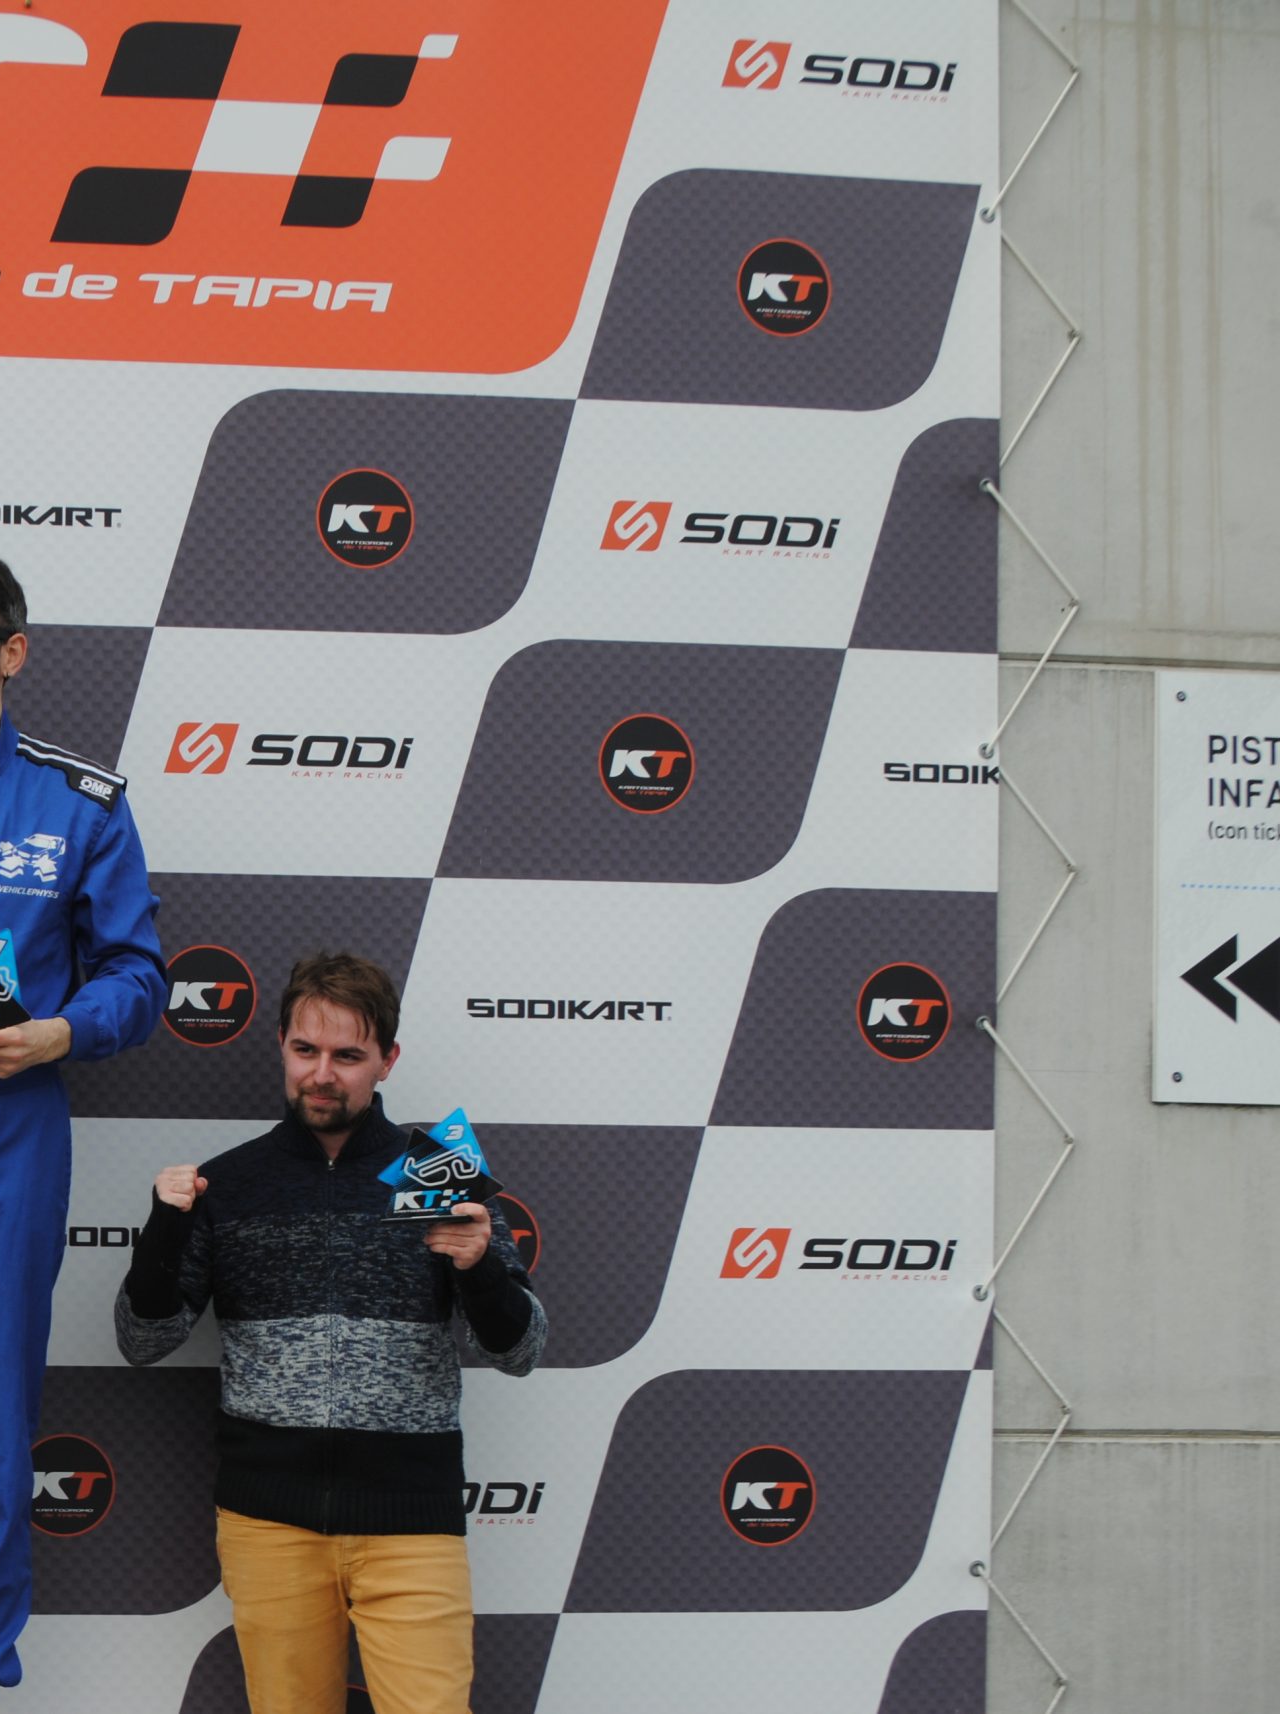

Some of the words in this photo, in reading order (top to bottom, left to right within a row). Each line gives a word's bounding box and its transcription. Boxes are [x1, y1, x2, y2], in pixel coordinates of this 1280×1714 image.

[23, 265, 117, 299] de
[140, 274, 392, 312] TAPIA
[747, 273, 824, 303] KT
[327, 504, 407, 533] KT
[609, 749, 687, 779] KT
[1209, 735, 1280, 766] PIST
[80, 775, 114, 799] OMP
[1208, 778, 1280, 808] INFA
[1208, 821, 1248, 840] (con
[168, 981, 249, 1011] KT
[467, 998, 671, 1022] SODIKART
[867, 998, 944, 1027] KT
[444, 1123, 465, 1142] 3
[393, 1189, 442, 1209] KT
[31, 1471, 107, 1501] KT
[730, 1482, 808, 1512] KT
